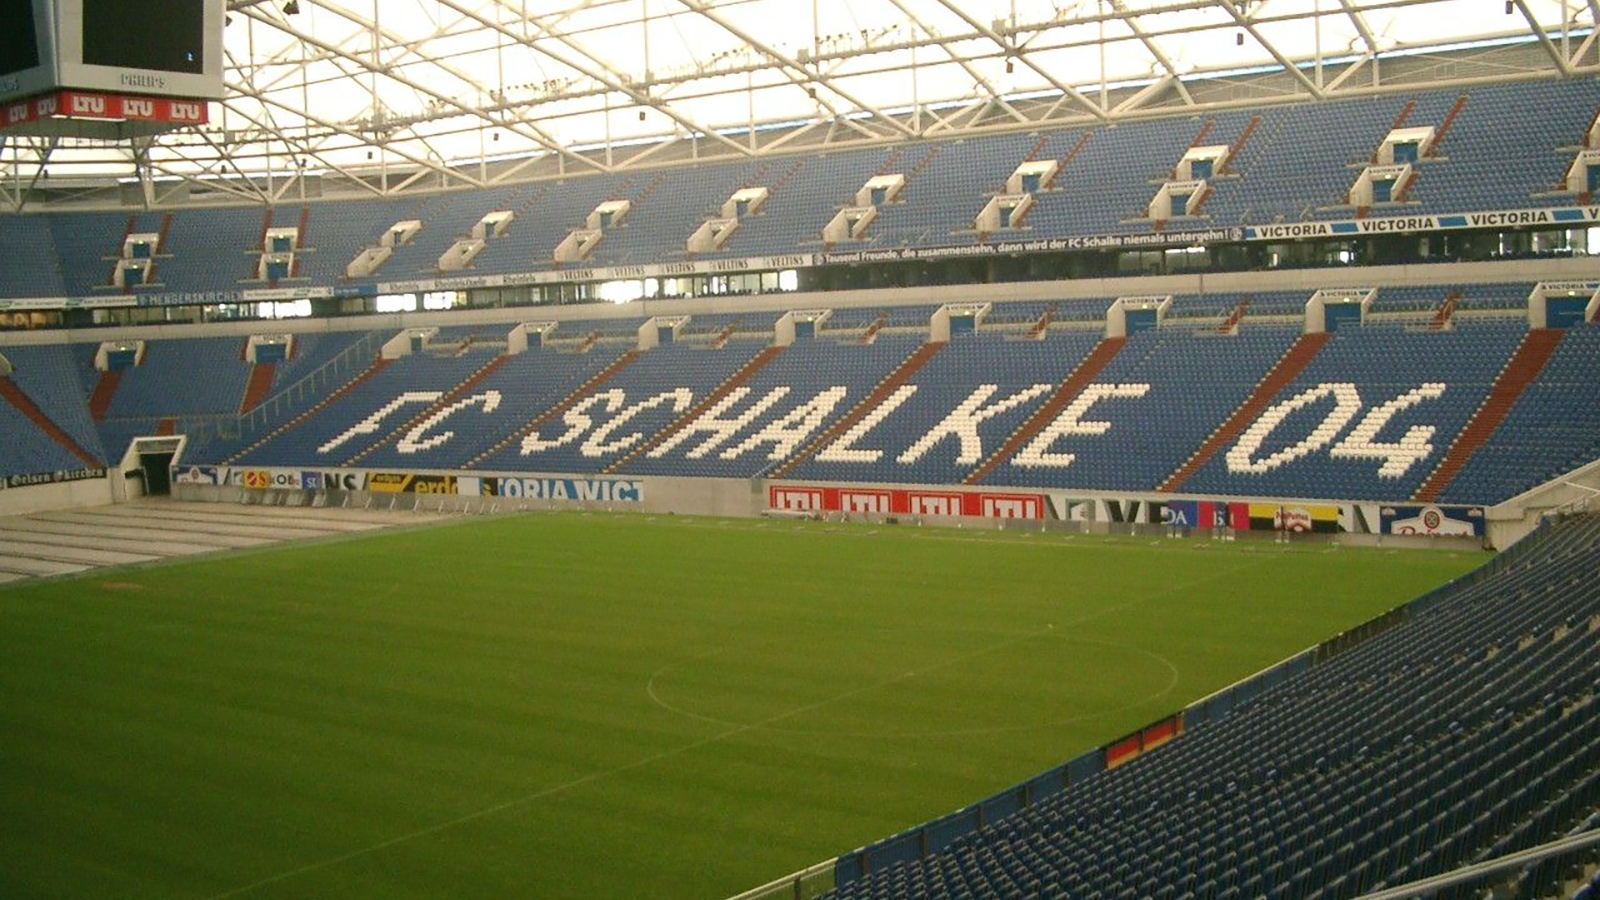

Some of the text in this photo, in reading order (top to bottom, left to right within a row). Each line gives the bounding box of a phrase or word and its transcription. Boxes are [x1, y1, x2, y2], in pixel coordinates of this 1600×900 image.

[120, 73, 165, 88] PHILIPS
[38, 97, 56, 115] LTU
[73, 95, 104, 113] LTU
[123, 99, 153, 116] LTU
[171, 102, 200, 119] LTU
[10, 103, 28, 122] LTU
[1361, 217, 1435, 231] VICTORIA
[1471, 211, 1548, 225] VICTORIA
[1259, 223, 1328, 237] VICTORIA
[825, 252, 860, 264] Tausend
[861, 250, 900, 262] Freunde,
[901, 249, 916, 258] die
[917, 244, 996, 257] zusammenstehn,
[997, 242, 1023, 252] dann
[1024, 241, 1048, 251] wird
[1049, 239, 1067, 249] der
[1068, 238, 1082, 248] FC
[1083, 235, 1122, 247] Schalke
[1123, 233, 1165, 245] niemals
[666, 262, 696, 273] VELTINS
[717, 258, 749, 270] VELTINS
[771, 255, 805, 267] VELTINS
[564, 269, 594, 280] VELTINS
[614, 265, 645, 276] VELTINS
[317, 382, 1447, 480] FC SCHALKE 04
